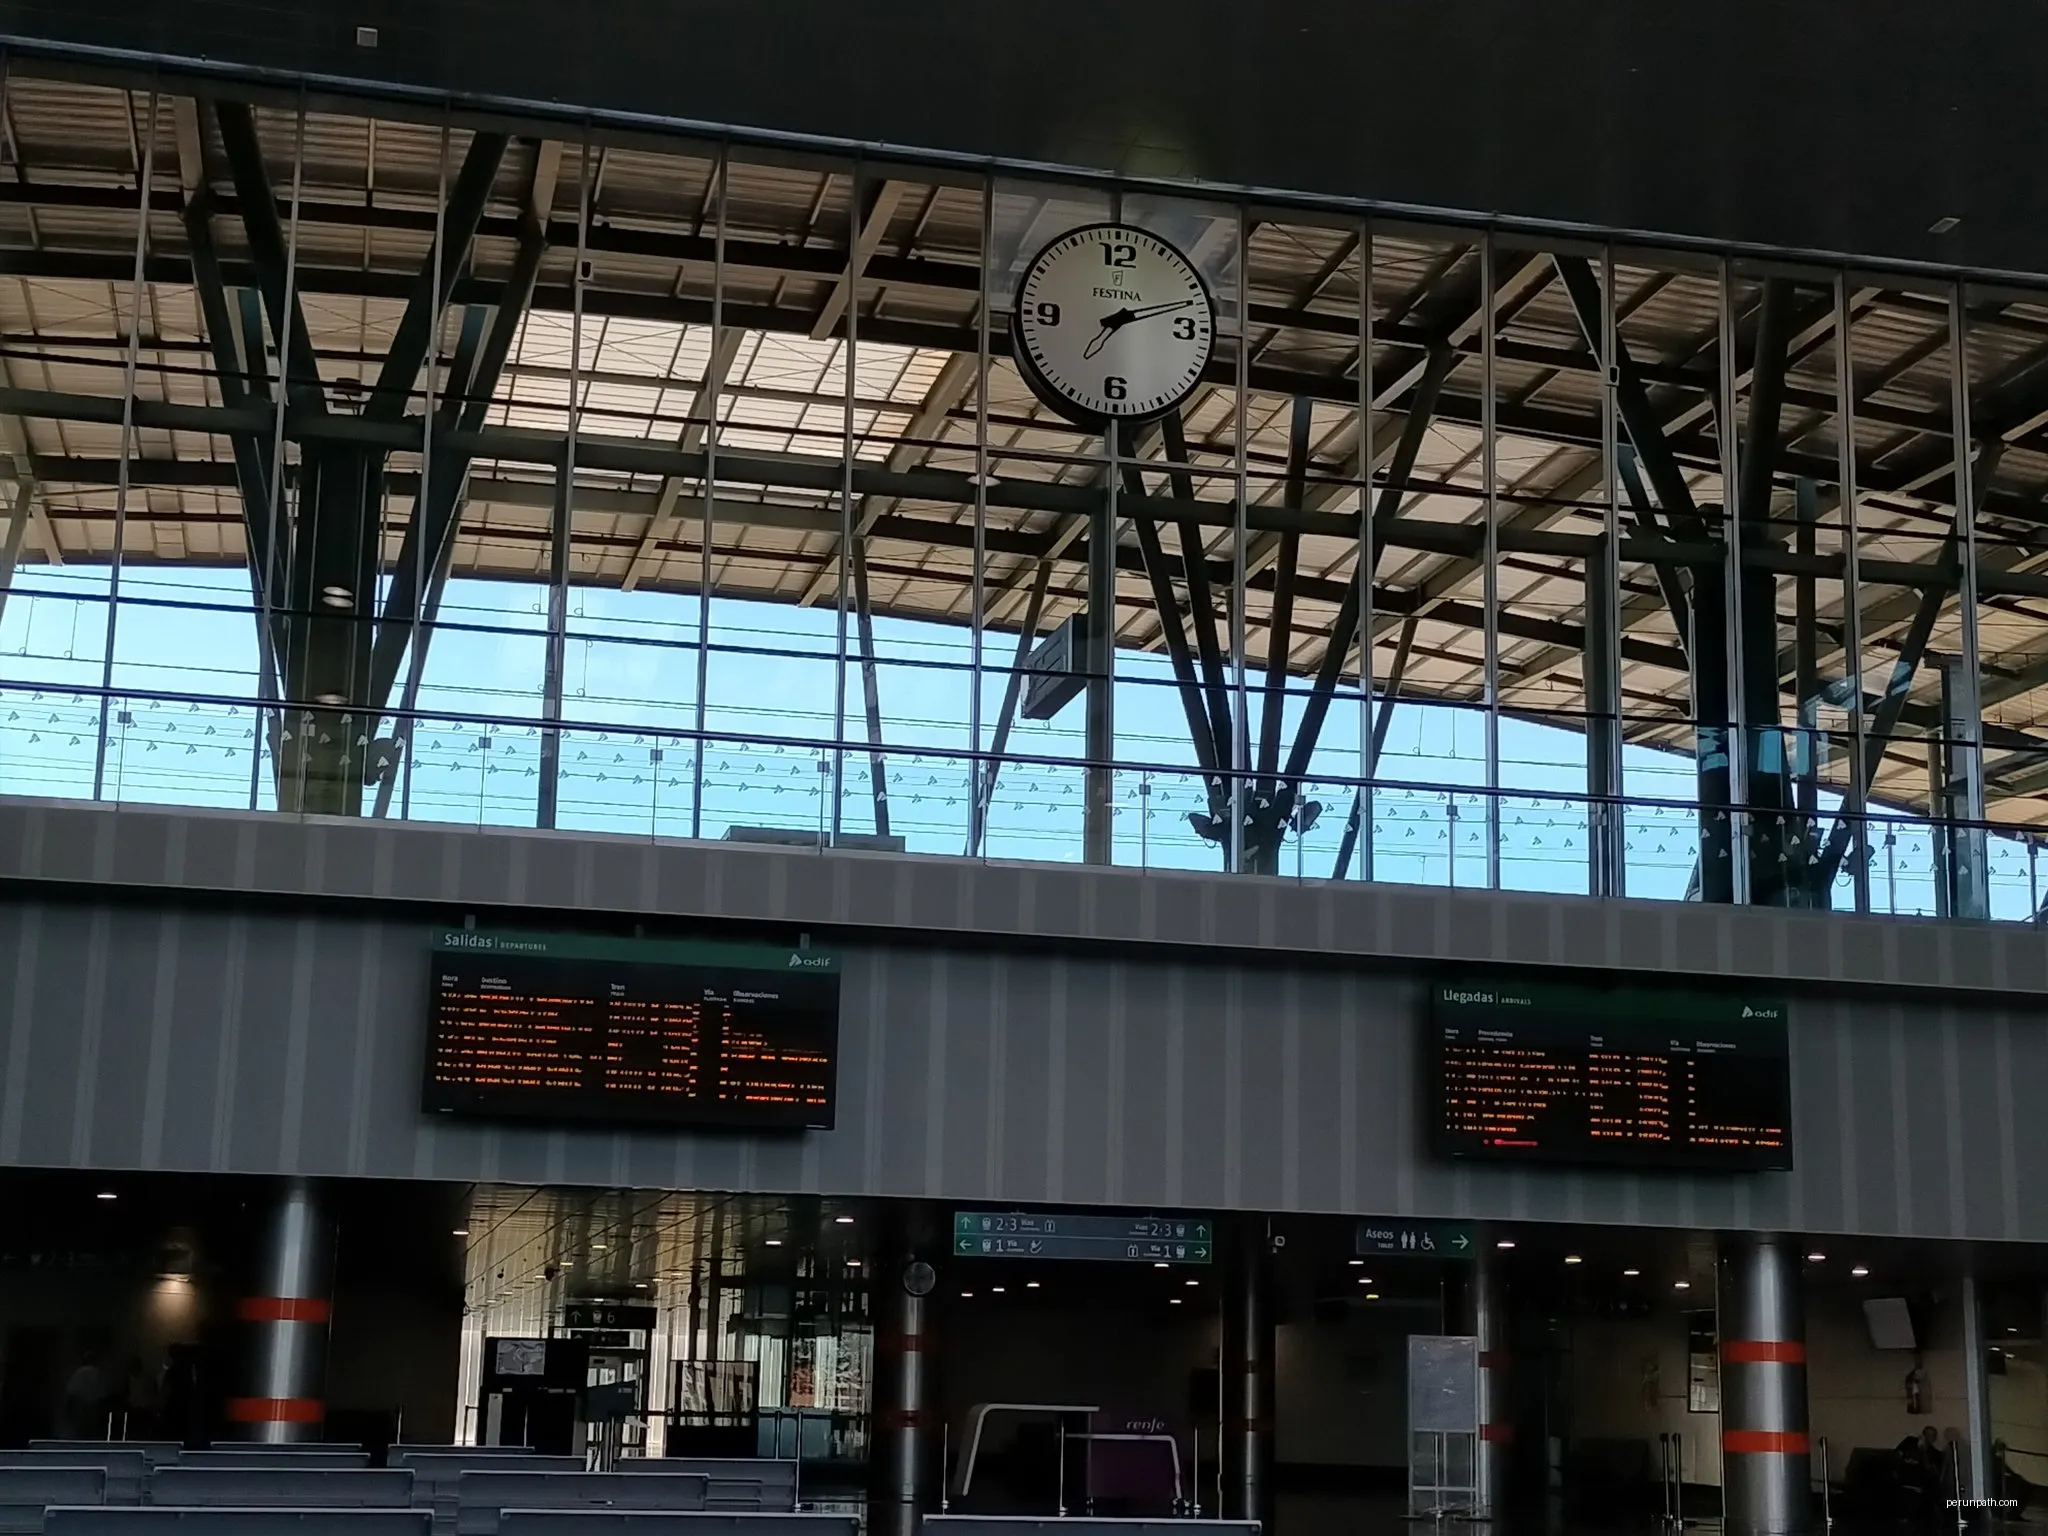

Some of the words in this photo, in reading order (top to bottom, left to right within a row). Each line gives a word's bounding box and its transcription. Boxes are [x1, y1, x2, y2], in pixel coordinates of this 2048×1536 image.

[1098, 242, 1137, 269] 12
[1092, 287, 1142, 302] FESTINA
[1036, 302, 1061, 327] 9
[1172, 316, 1196, 341] 3
[1103, 376, 1128, 400] 6
[444, 933, 493, 948] Salidas
[803, 957, 832, 967] adif
[1443, 989, 1494, 1004] Llegadas
[1754, 1009, 1779, 1019] adif
[1365, 1228, 1394, 1240] Aseos
[996, 1239, 1004, 1253] 1
[1163, 1245, 1172, 1258] 1
[606, 1310, 616, 1324] 6
[1126, 1418, 1165, 1433] renfe
